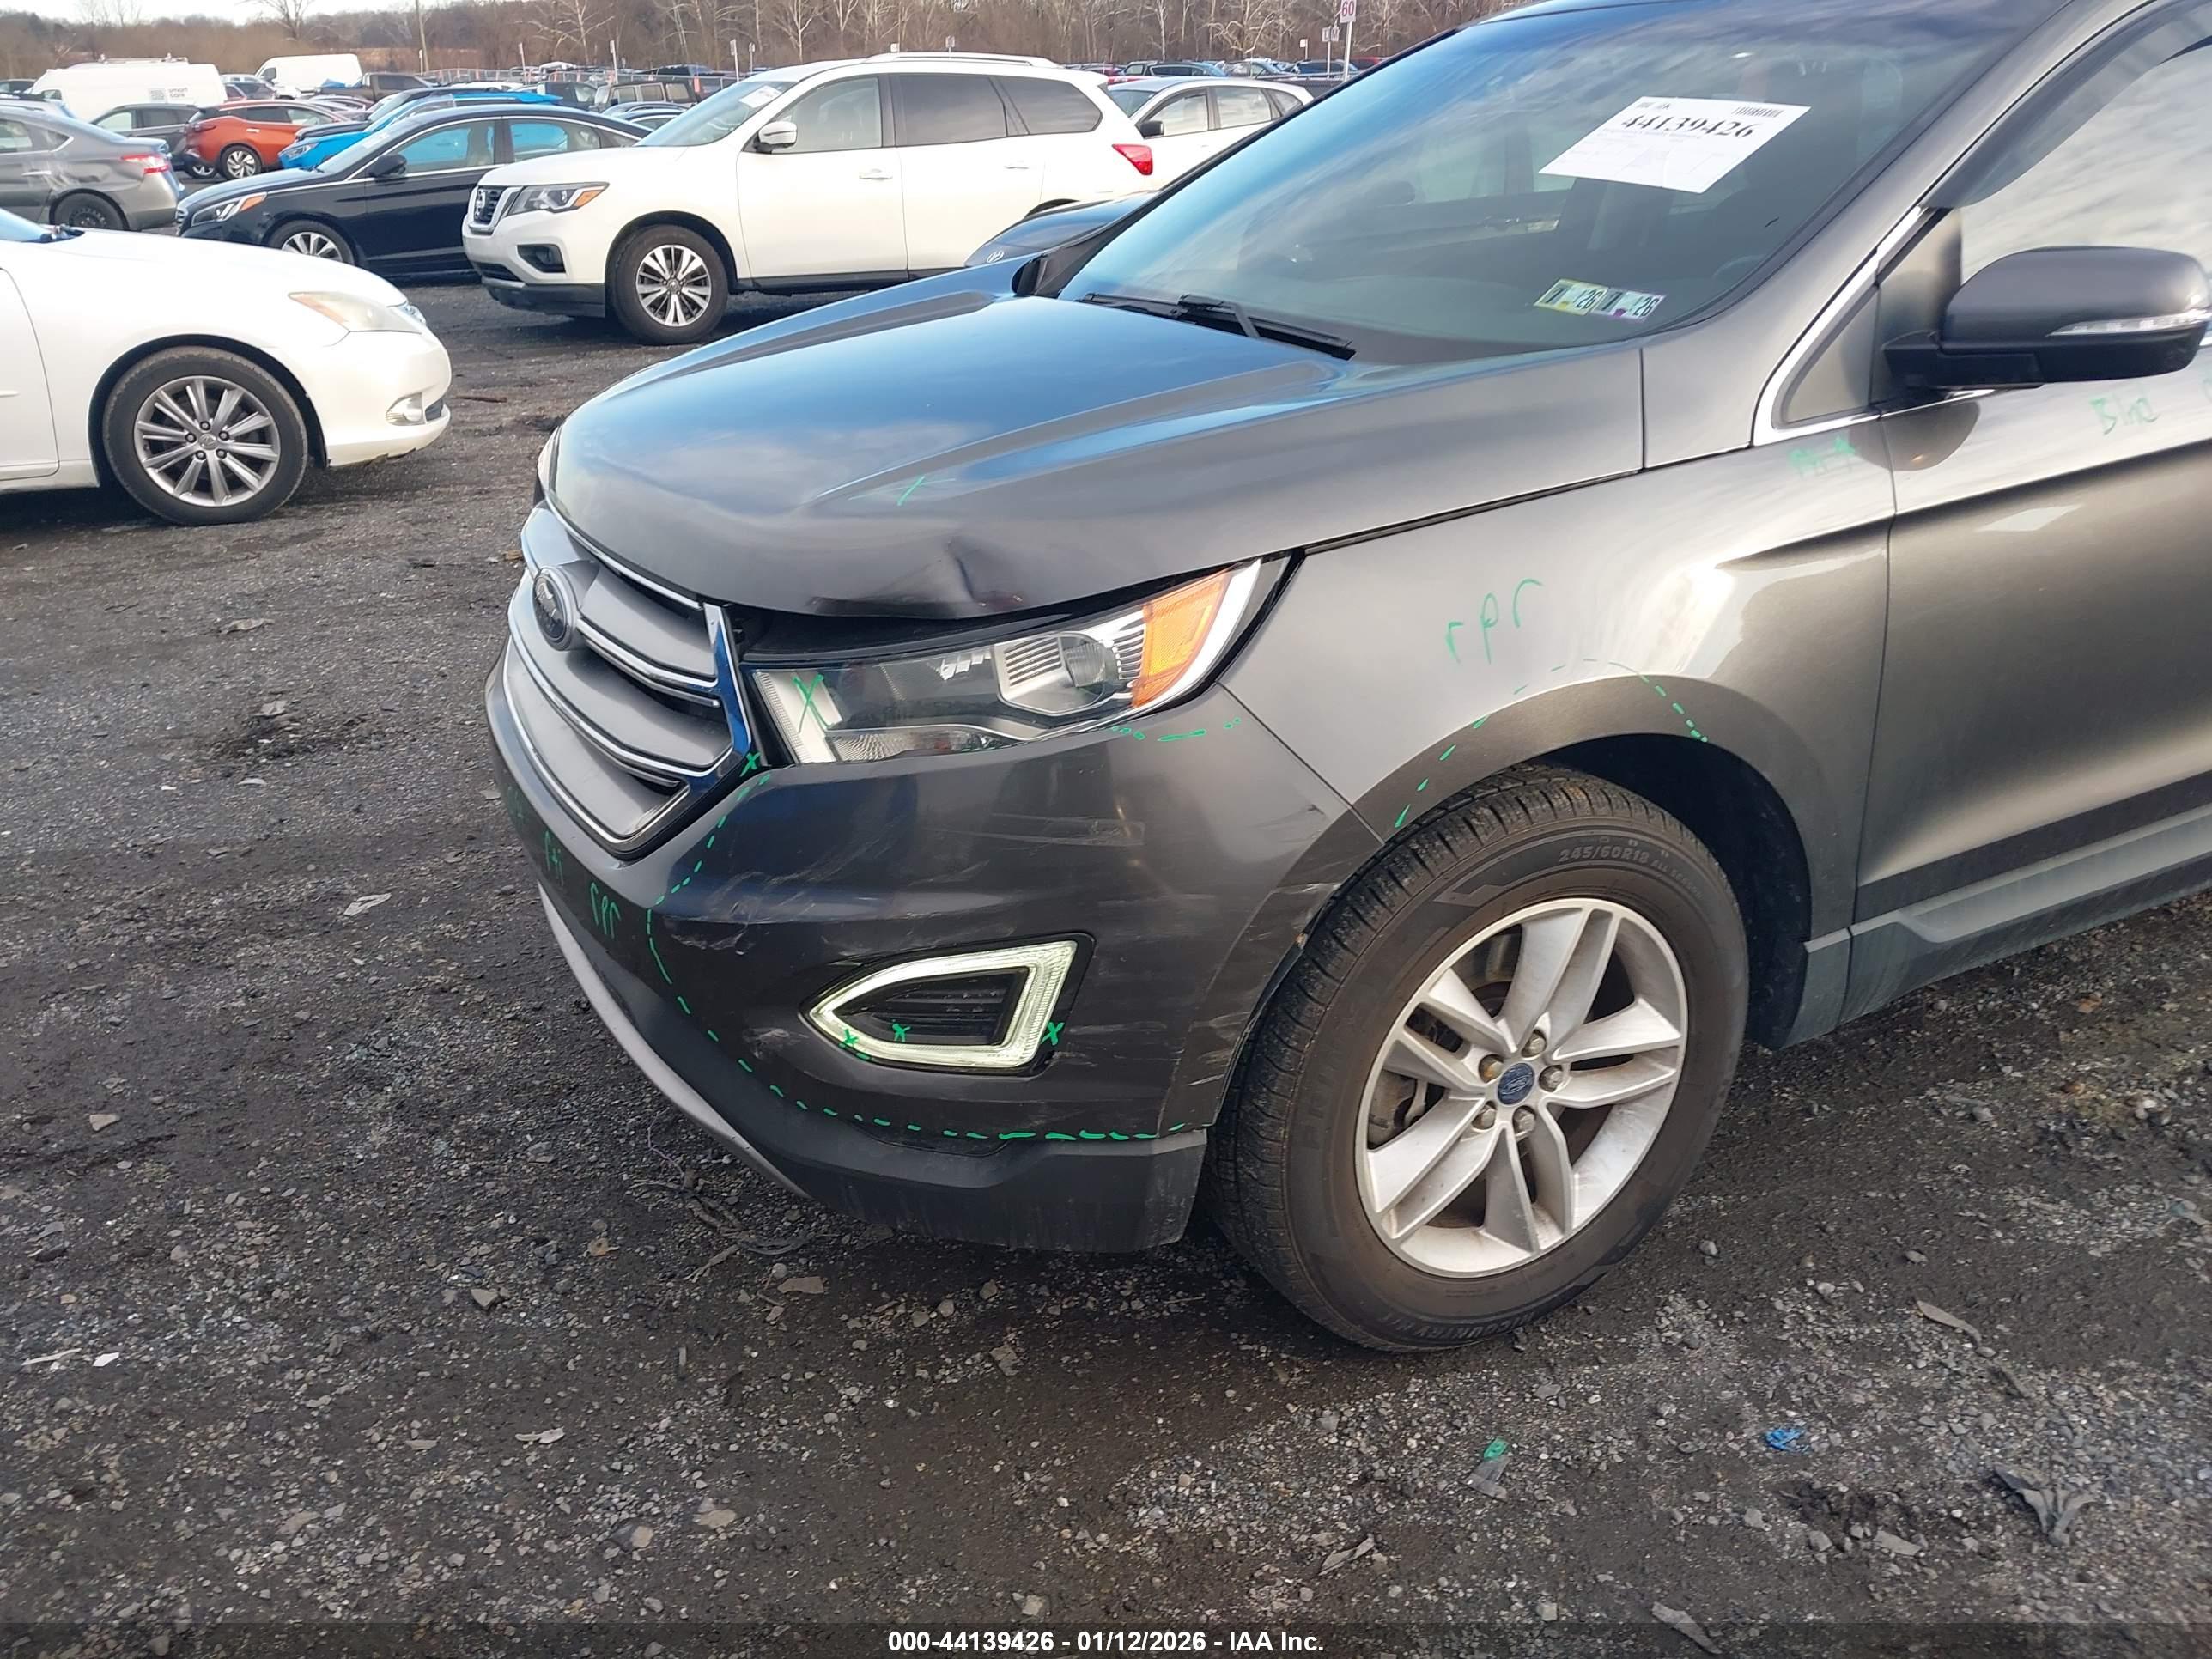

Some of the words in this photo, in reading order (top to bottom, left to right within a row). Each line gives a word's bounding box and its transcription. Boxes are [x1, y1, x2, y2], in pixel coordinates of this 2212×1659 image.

[1342, 1, 1354, 16] 60
[1621, 114, 1757, 138] 44139426
[1559, 844, 1650, 864] 245/60R18
